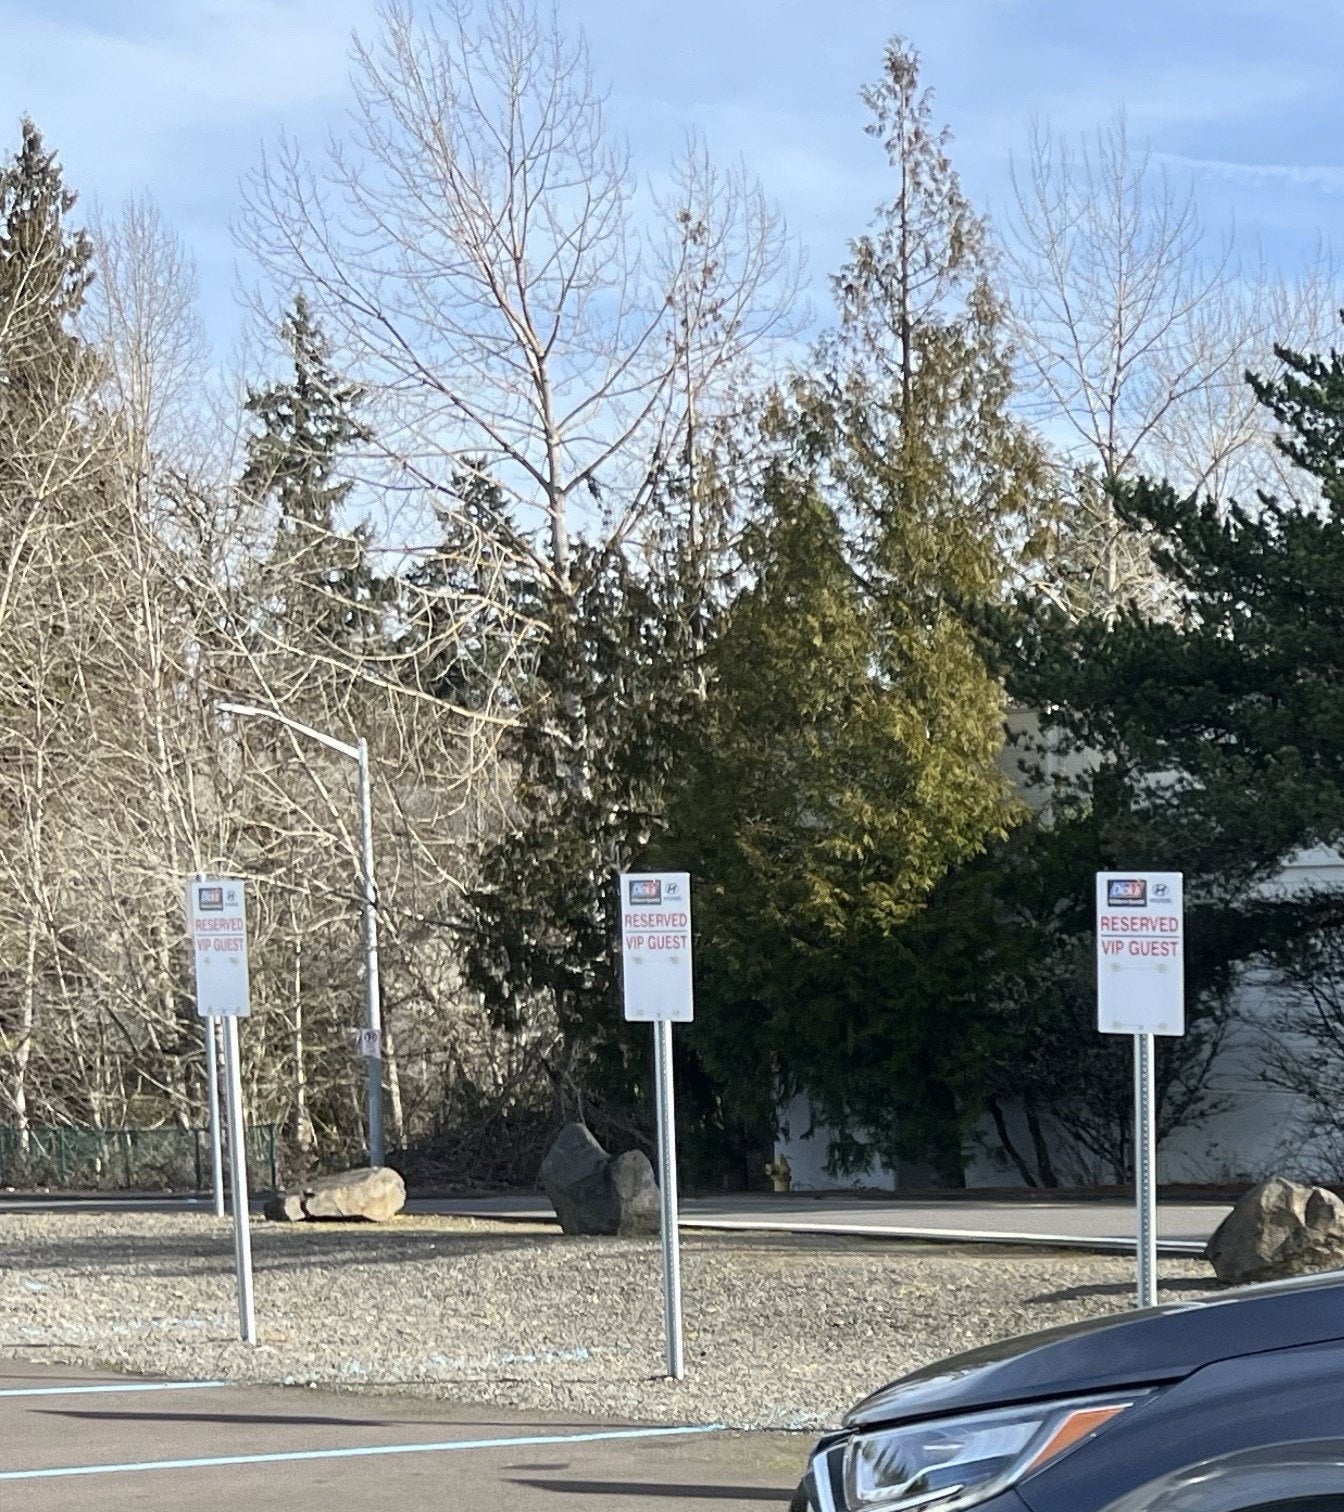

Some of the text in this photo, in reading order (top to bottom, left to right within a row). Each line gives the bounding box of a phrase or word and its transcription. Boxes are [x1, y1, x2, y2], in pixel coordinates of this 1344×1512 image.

[195, 917, 243, 932] RESERVED
[624, 913, 688, 928] RESERVED
[1100, 916, 1179, 932] RESERVED
[196, 937, 244, 952] VIP GUEST
[625, 935, 687, 950] VIP GUEST
[1101, 940, 1179, 956] VIP GUEST
